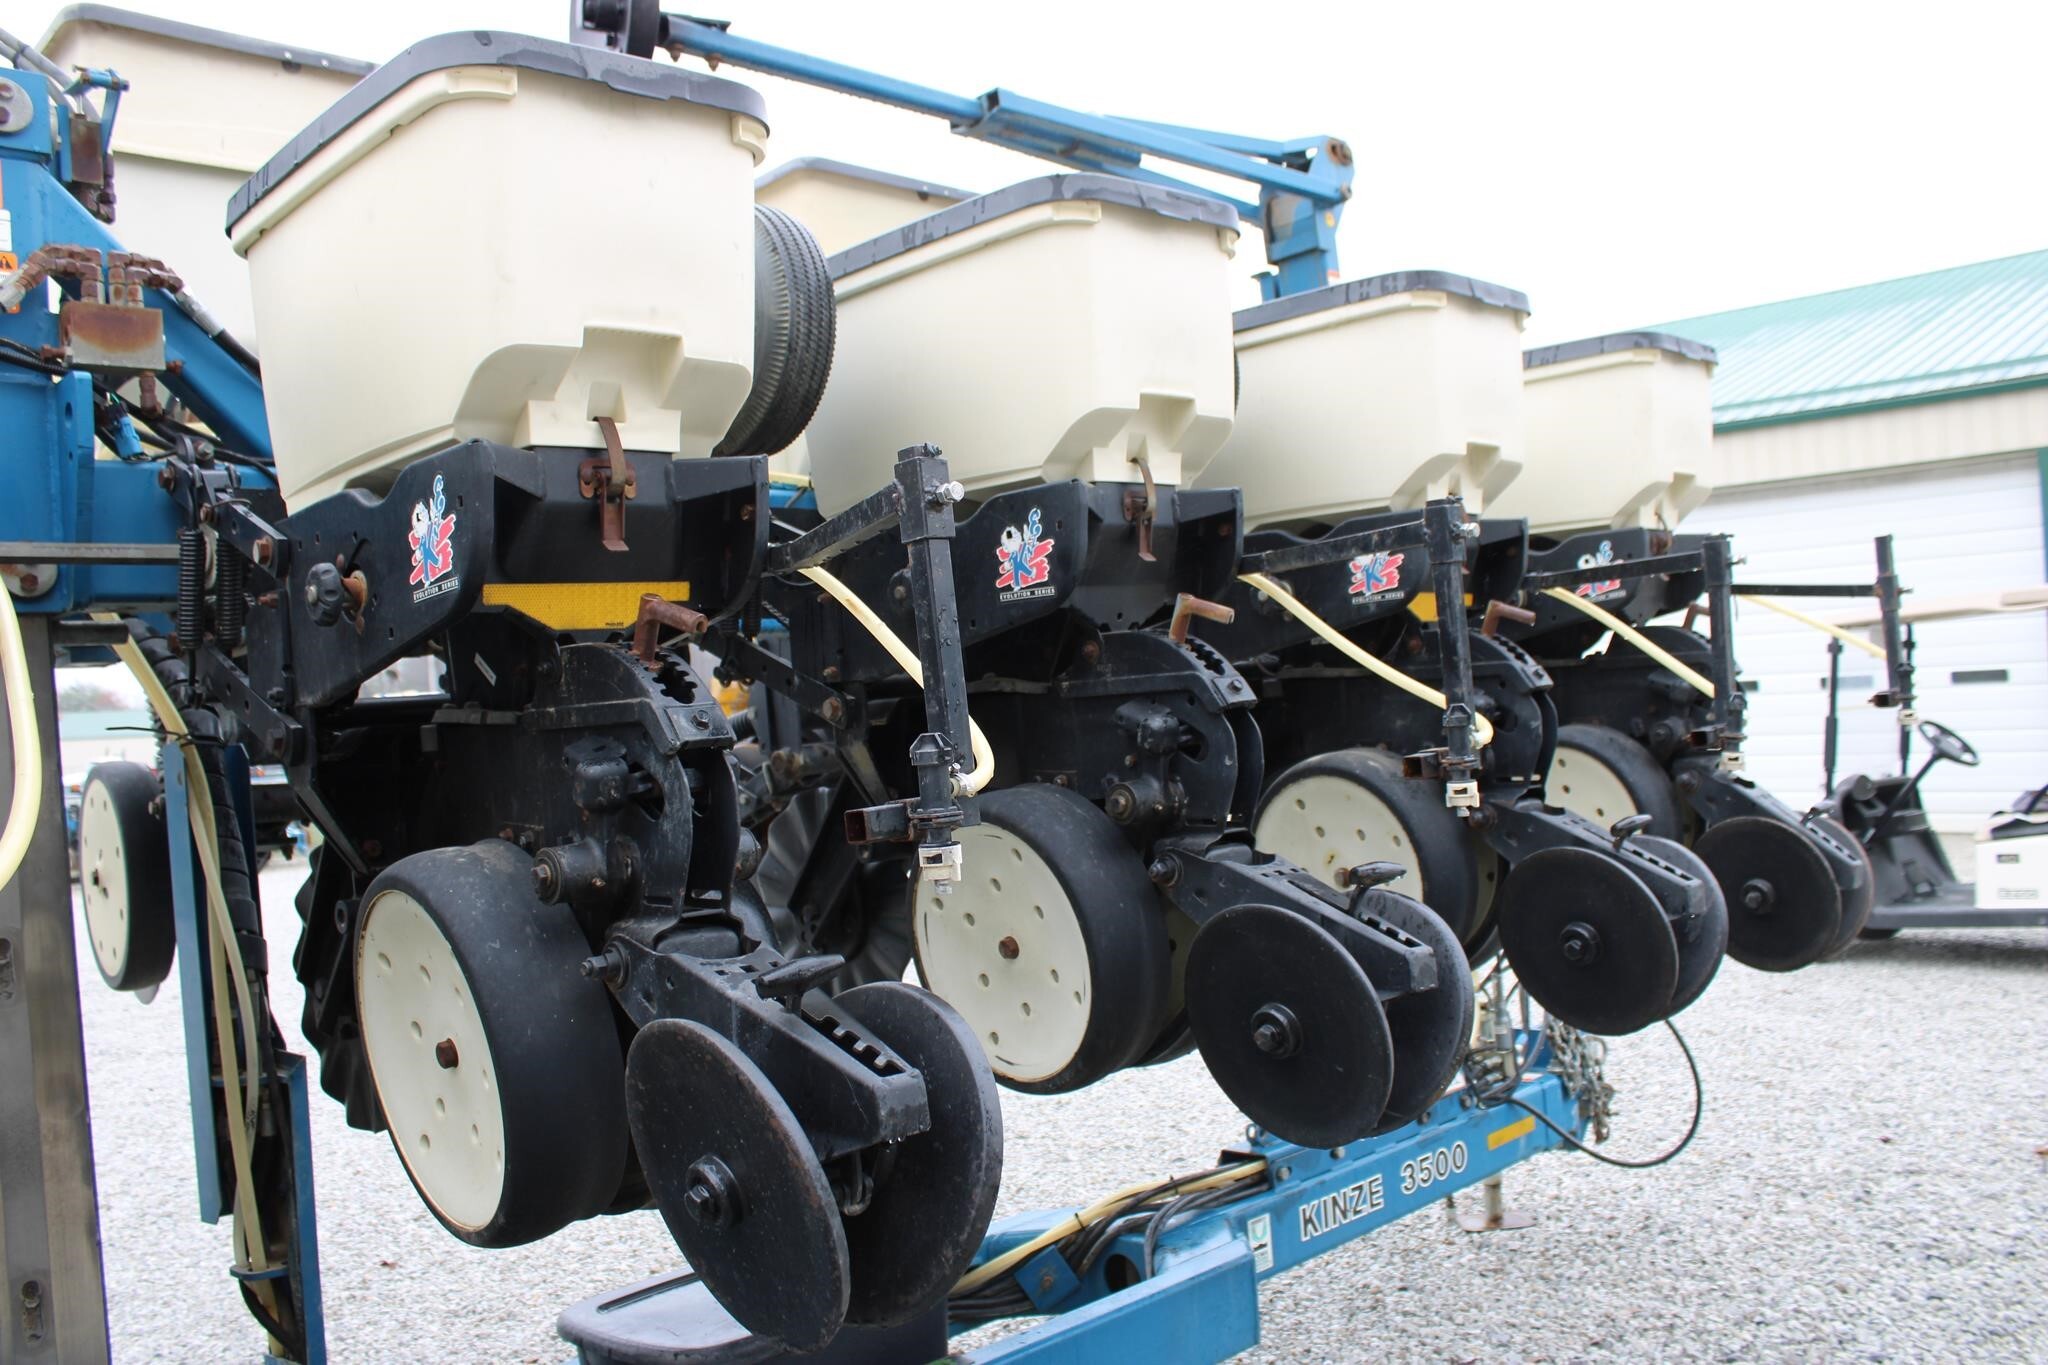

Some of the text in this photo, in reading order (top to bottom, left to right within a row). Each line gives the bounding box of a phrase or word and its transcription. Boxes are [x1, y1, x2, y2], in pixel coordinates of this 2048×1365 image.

[413, 579, 458, 601] EVOLUTION SERIES
[1000, 588, 1055, 601] EVOLUTION SERIES
[1300, 1141, 1467, 1242] KINZE 3500
